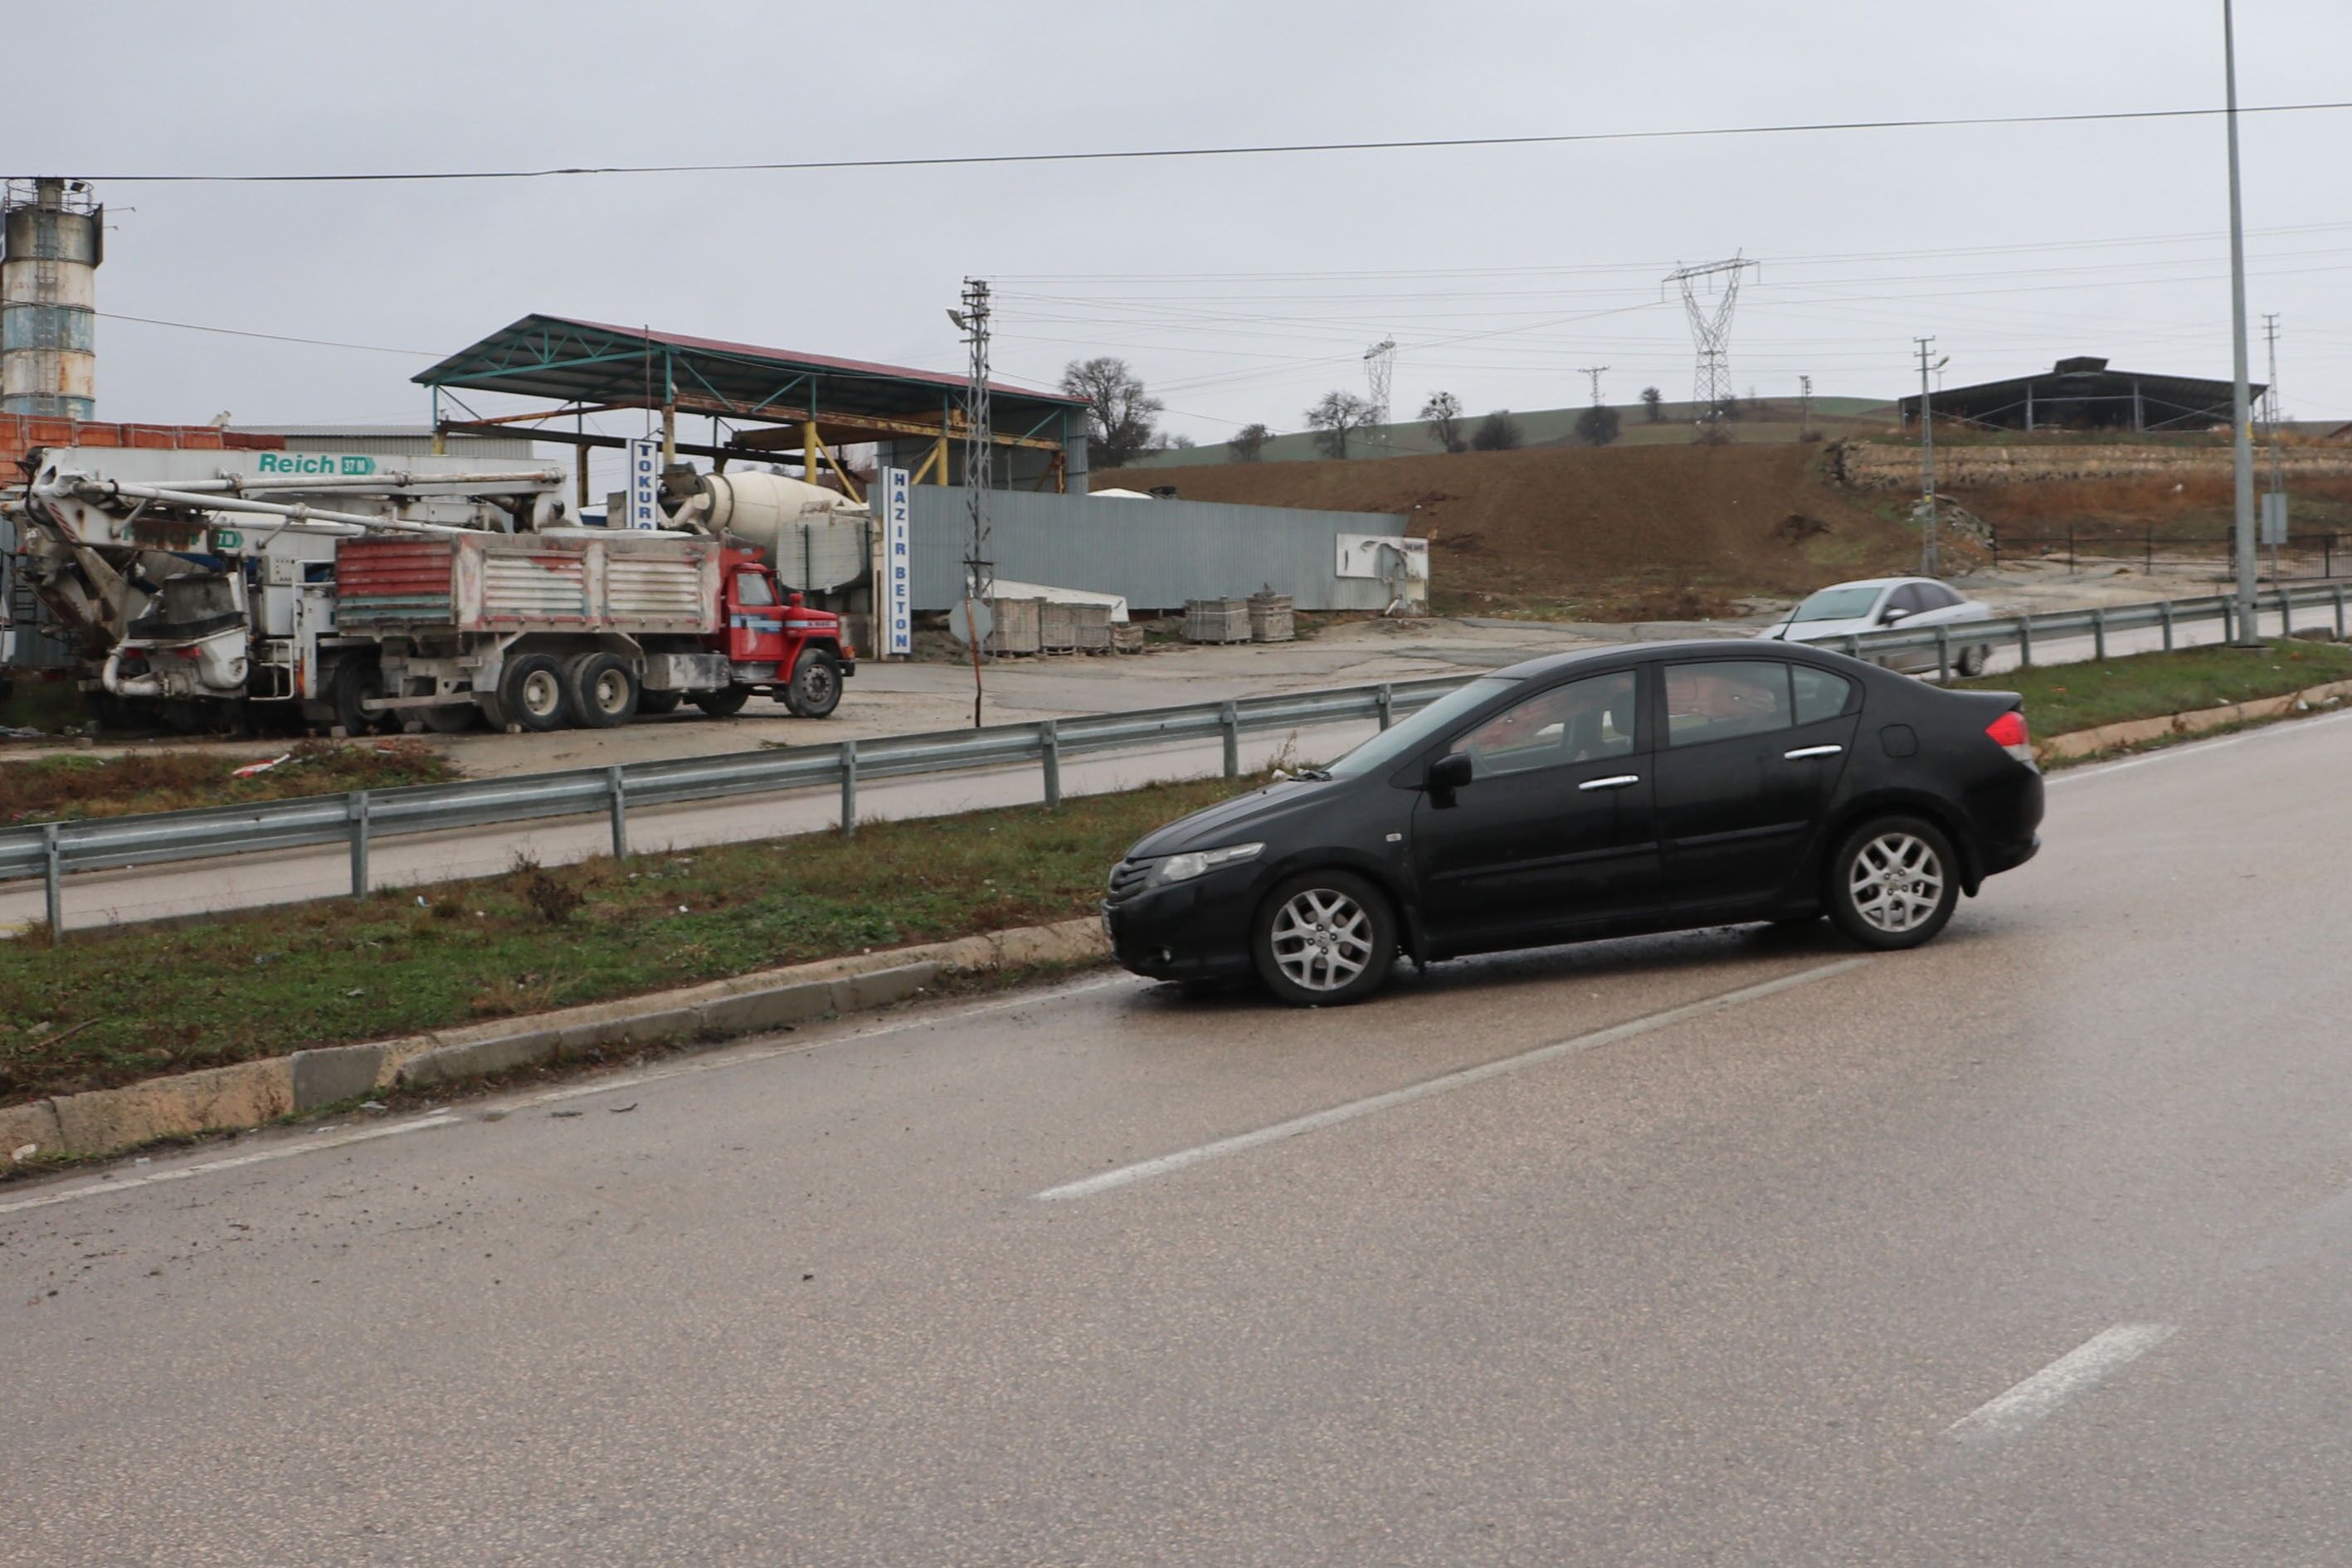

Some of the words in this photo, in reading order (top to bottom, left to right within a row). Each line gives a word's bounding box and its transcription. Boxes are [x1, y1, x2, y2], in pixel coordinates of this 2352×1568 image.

[259, 453, 335, 474] Reich
[894, 473, 906, 555] HAZIR
[895, 567, 907, 647] BETON
